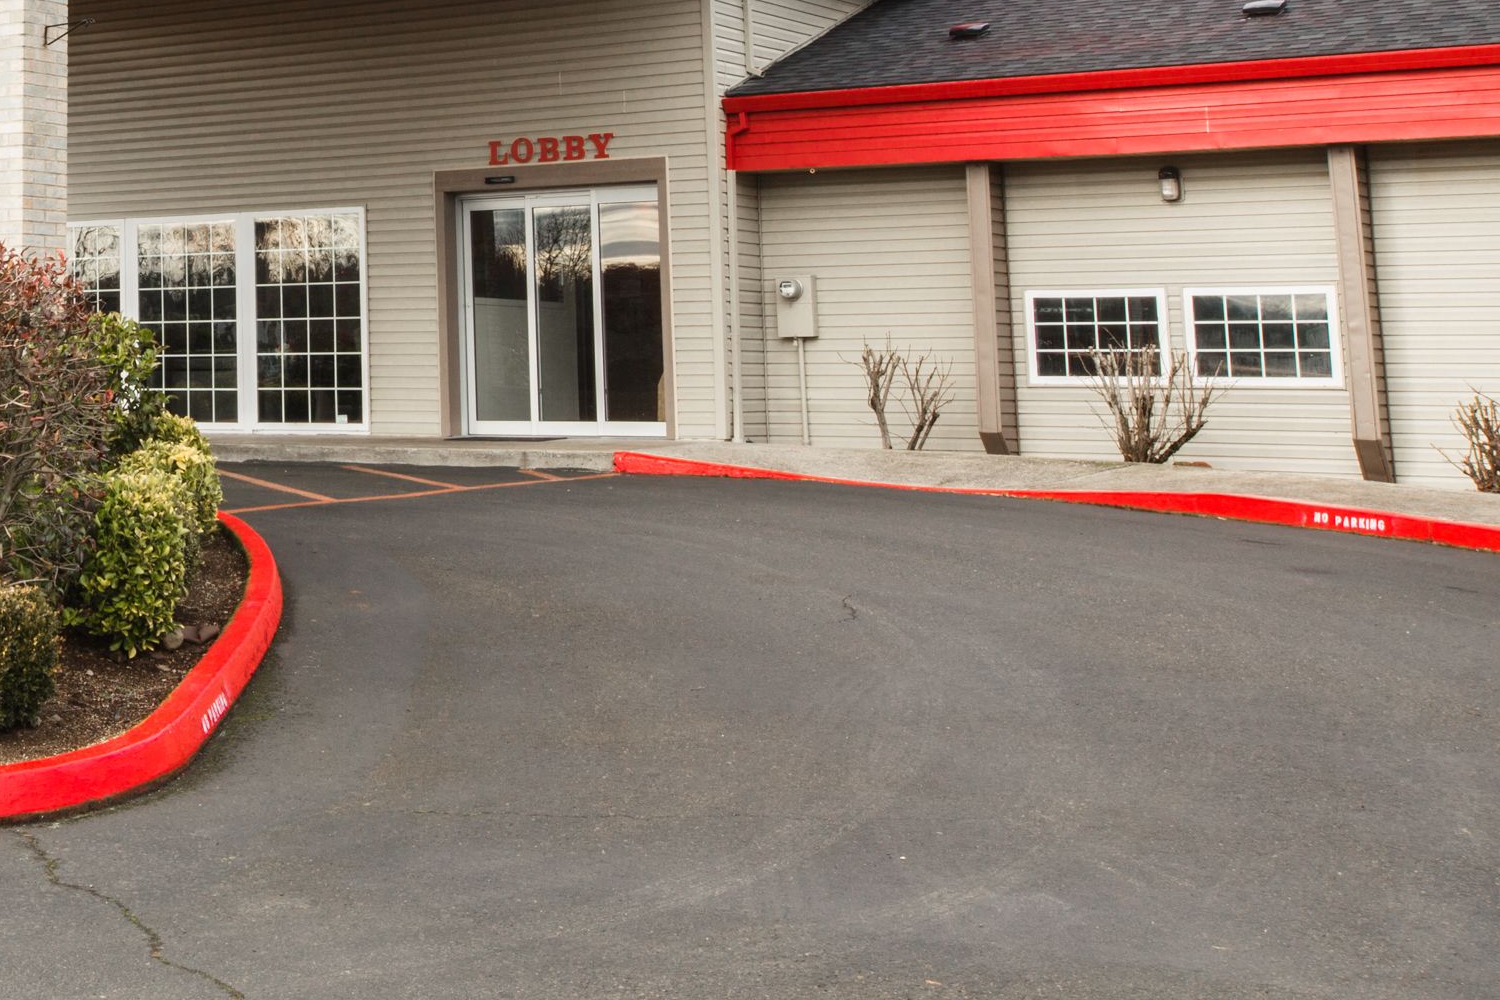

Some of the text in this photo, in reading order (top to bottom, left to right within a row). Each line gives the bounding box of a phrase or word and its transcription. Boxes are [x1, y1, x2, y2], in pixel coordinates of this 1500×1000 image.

[488, 132, 614, 166] LOBBY
[1314, 512, 1386, 531] NO PARKING
